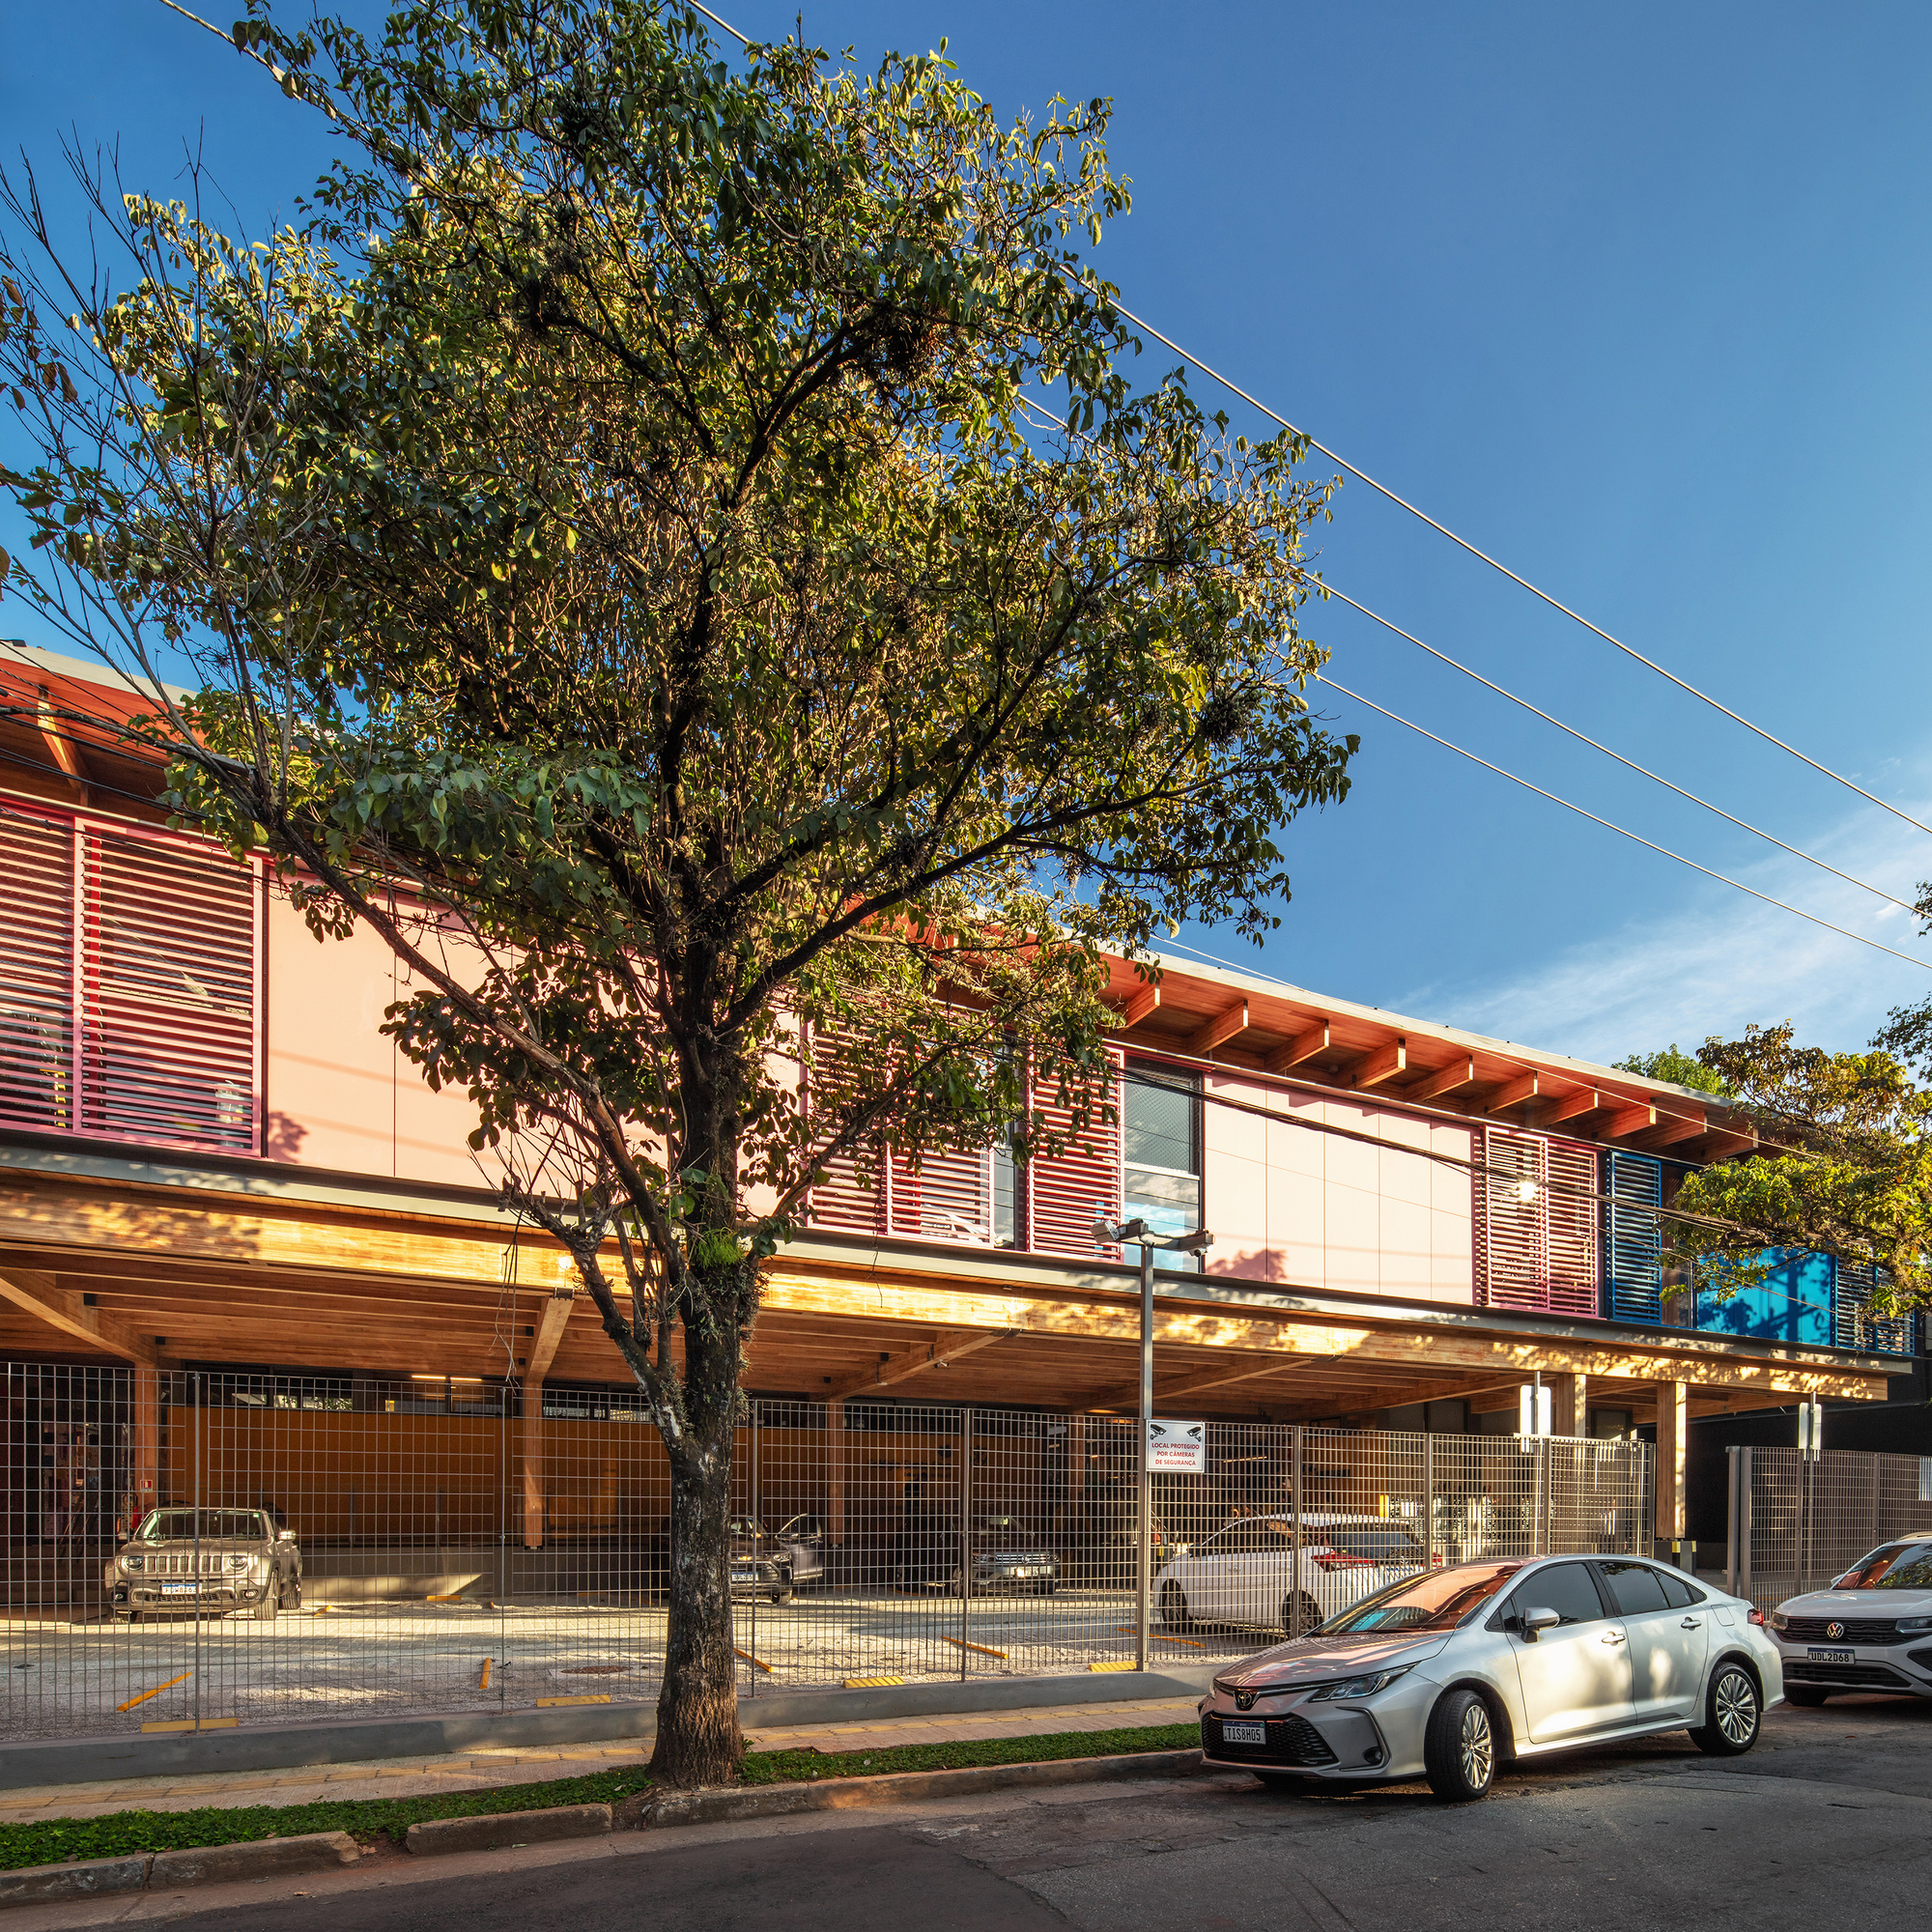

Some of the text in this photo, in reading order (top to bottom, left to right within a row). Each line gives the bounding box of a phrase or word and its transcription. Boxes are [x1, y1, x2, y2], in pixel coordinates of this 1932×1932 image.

[1169, 1449, 1195, 1458] CÂMERAS
[1811, 1652, 1850, 1662] UDL2D68
[1227, 1727, 1262, 1742] TIS8H05
